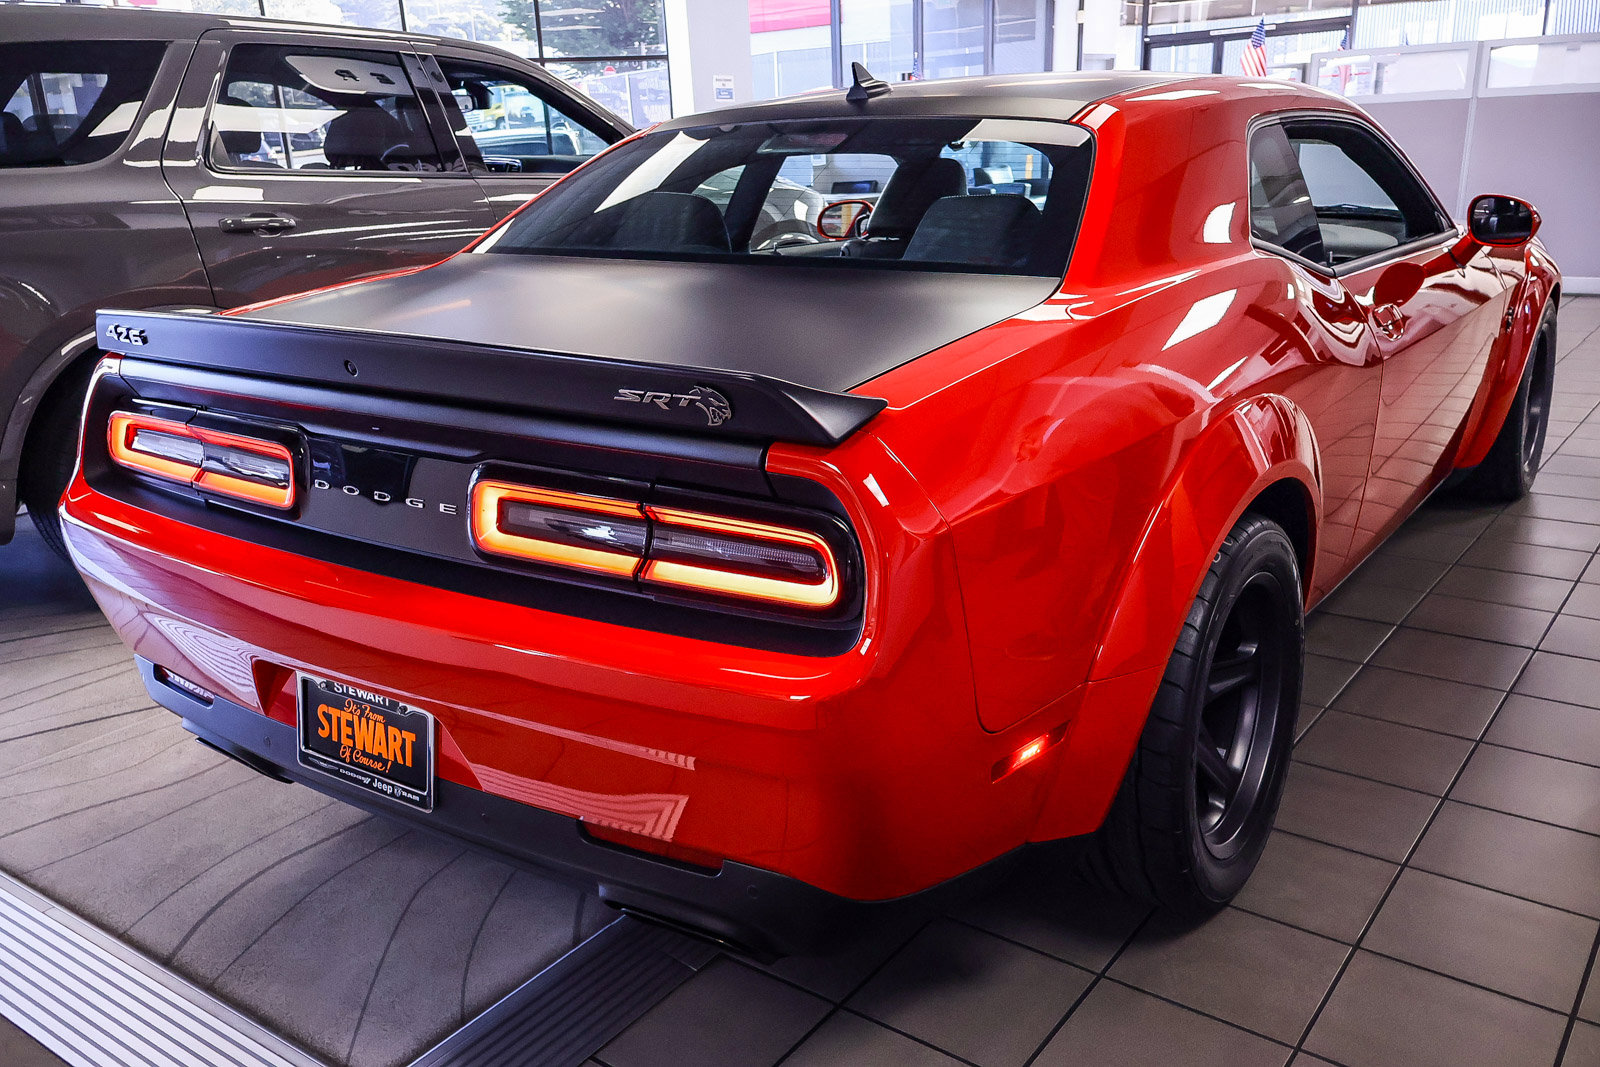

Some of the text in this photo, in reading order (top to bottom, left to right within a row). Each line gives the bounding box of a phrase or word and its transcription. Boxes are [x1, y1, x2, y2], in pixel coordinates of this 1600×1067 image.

[105, 323, 146, 346] 426
[613, 388, 701, 410] SRT
[314, 479, 457, 515] DODGE
[333, 682, 390, 707] STEWART
[362, 704, 386, 723] From
[317, 703, 416, 767] STEWART
[339, 744, 352, 763] Of
[339, 768, 420, 802] DODGE Jeep RAM
